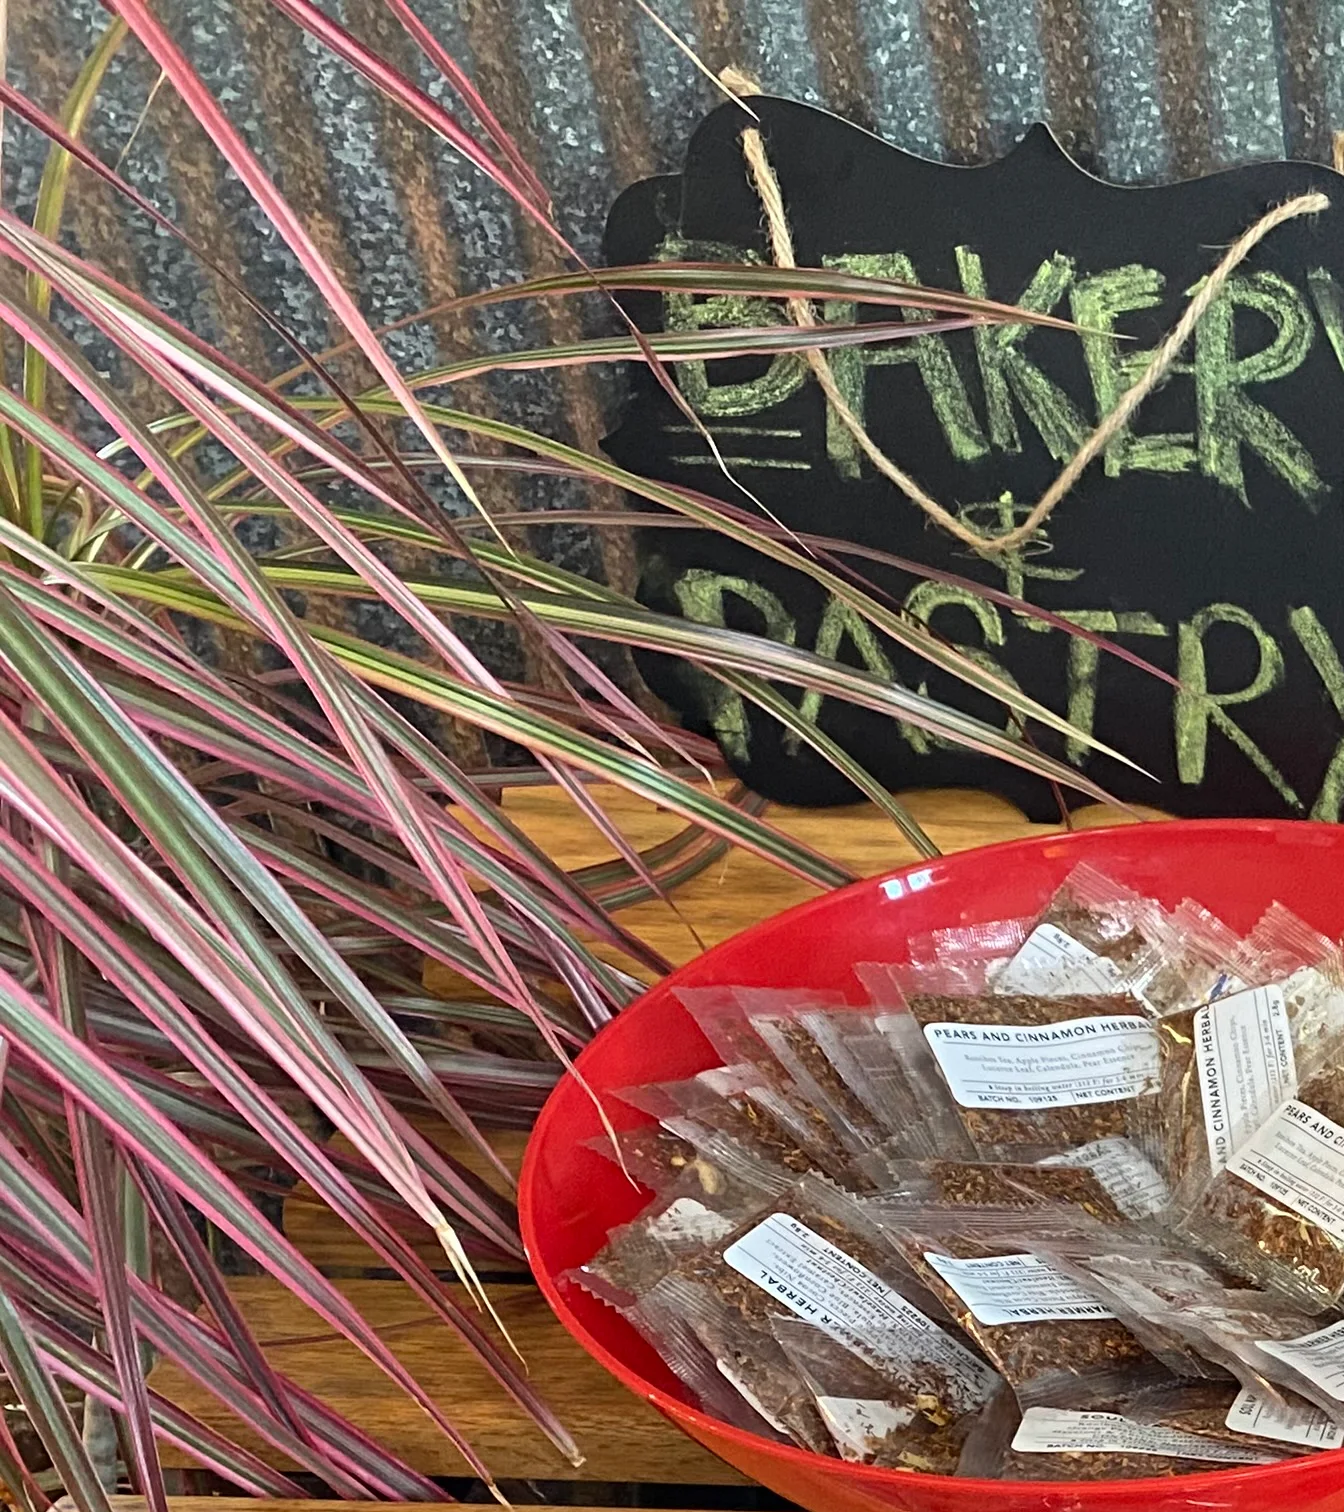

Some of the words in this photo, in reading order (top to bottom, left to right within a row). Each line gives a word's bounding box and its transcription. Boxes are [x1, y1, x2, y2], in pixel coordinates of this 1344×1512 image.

[934, 1029, 977, 1040] PEARS
[983, 1031, 1010, 1042] AND
[1015, 1024, 1097, 1043] CINNAMON
[1276, 1030, 1288, 1068] CONTENT
[1076, 1091, 1092, 1099] NET
[1094, 1085, 1136, 1096] CONTENT
[1205, 1056, 1224, 1132] CINNAMON
[1283, 1105, 1311, 1125] PEARS
[1310, 1122, 1334, 1139] AND
[1297, 1199, 1310, 1210] NET
[1308, 1203, 1337, 1225] CONTENT
[822, 1244, 866, 1280] CONTENT
[760, 1270, 818, 1316] HERBAL
[864, 1276, 886, 1295] NET
[1002, 1306, 1053, 1317] HERBAL
